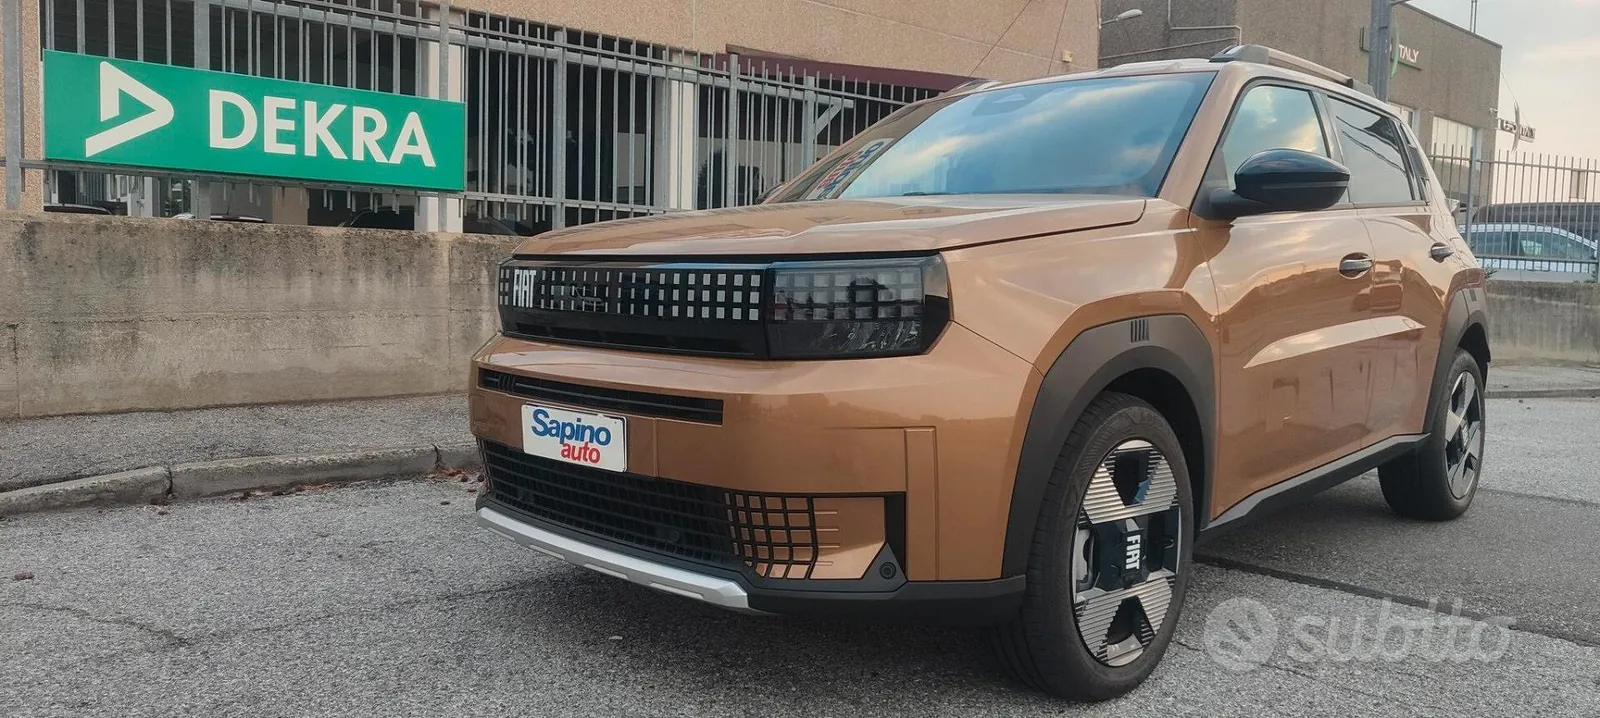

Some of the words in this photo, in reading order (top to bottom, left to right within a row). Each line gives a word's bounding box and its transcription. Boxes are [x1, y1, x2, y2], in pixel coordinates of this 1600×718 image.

[209, 89, 436, 167] DEKRA
[513, 269, 537, 308] FIAT
[531, 408, 611, 446] Sapino
[561, 441, 600, 463] auto
[1126, 535, 1140, 569] FIAT
